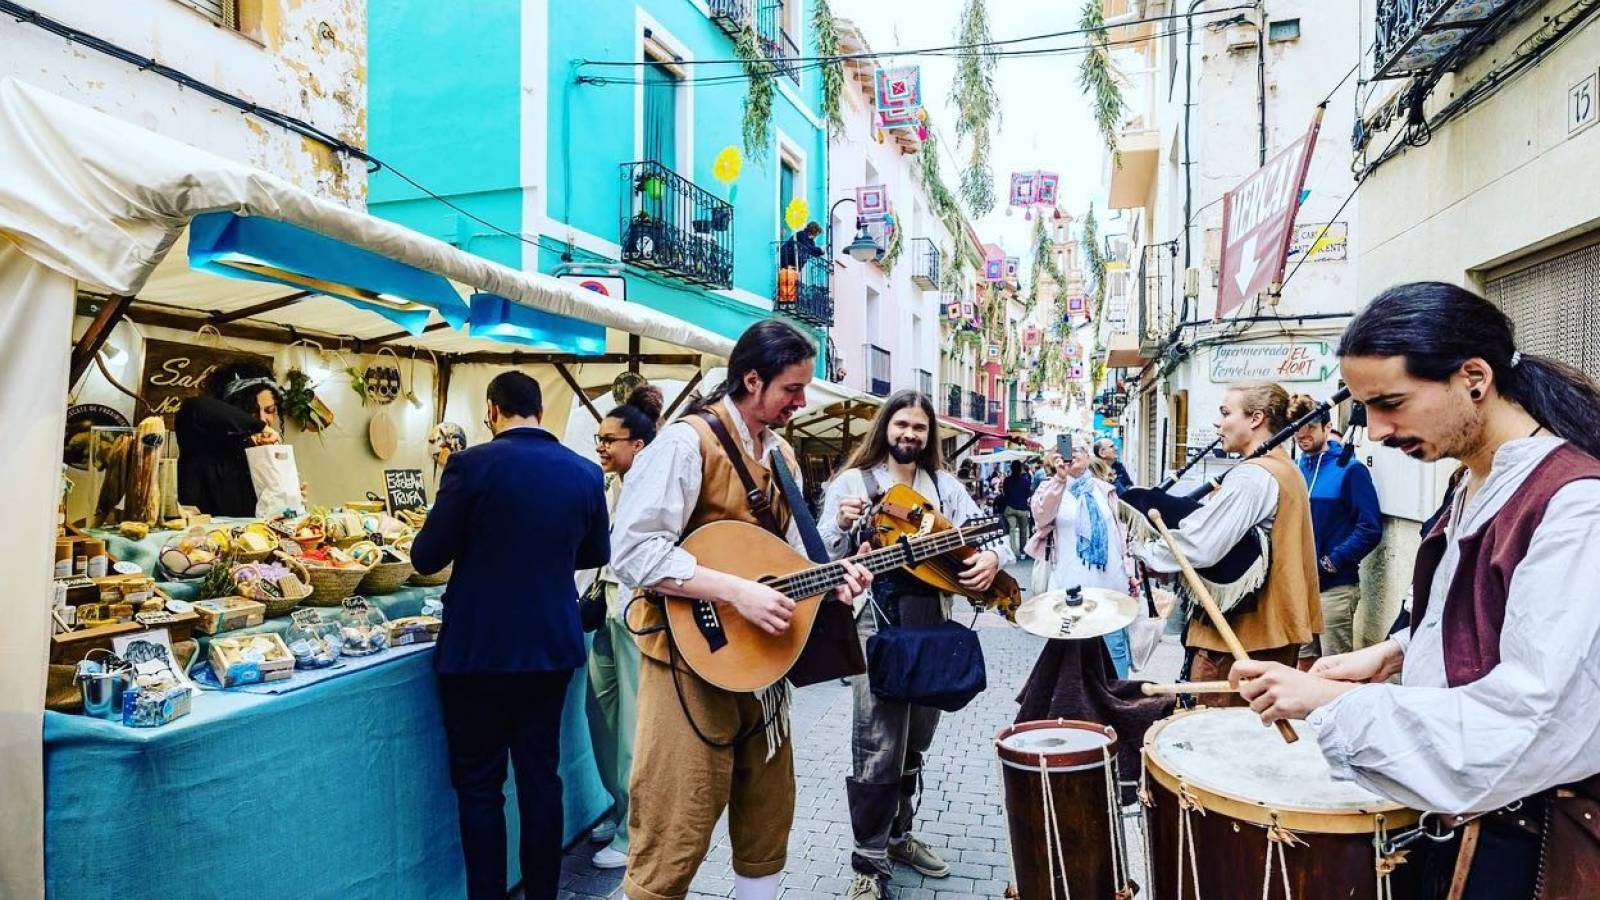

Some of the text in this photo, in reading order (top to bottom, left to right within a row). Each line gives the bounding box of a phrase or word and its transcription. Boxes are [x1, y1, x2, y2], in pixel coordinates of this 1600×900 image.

[1573, 82, 1590, 123] 15
[1290, 346, 1310, 361] EL
[1275, 359, 1316, 376] HORT
